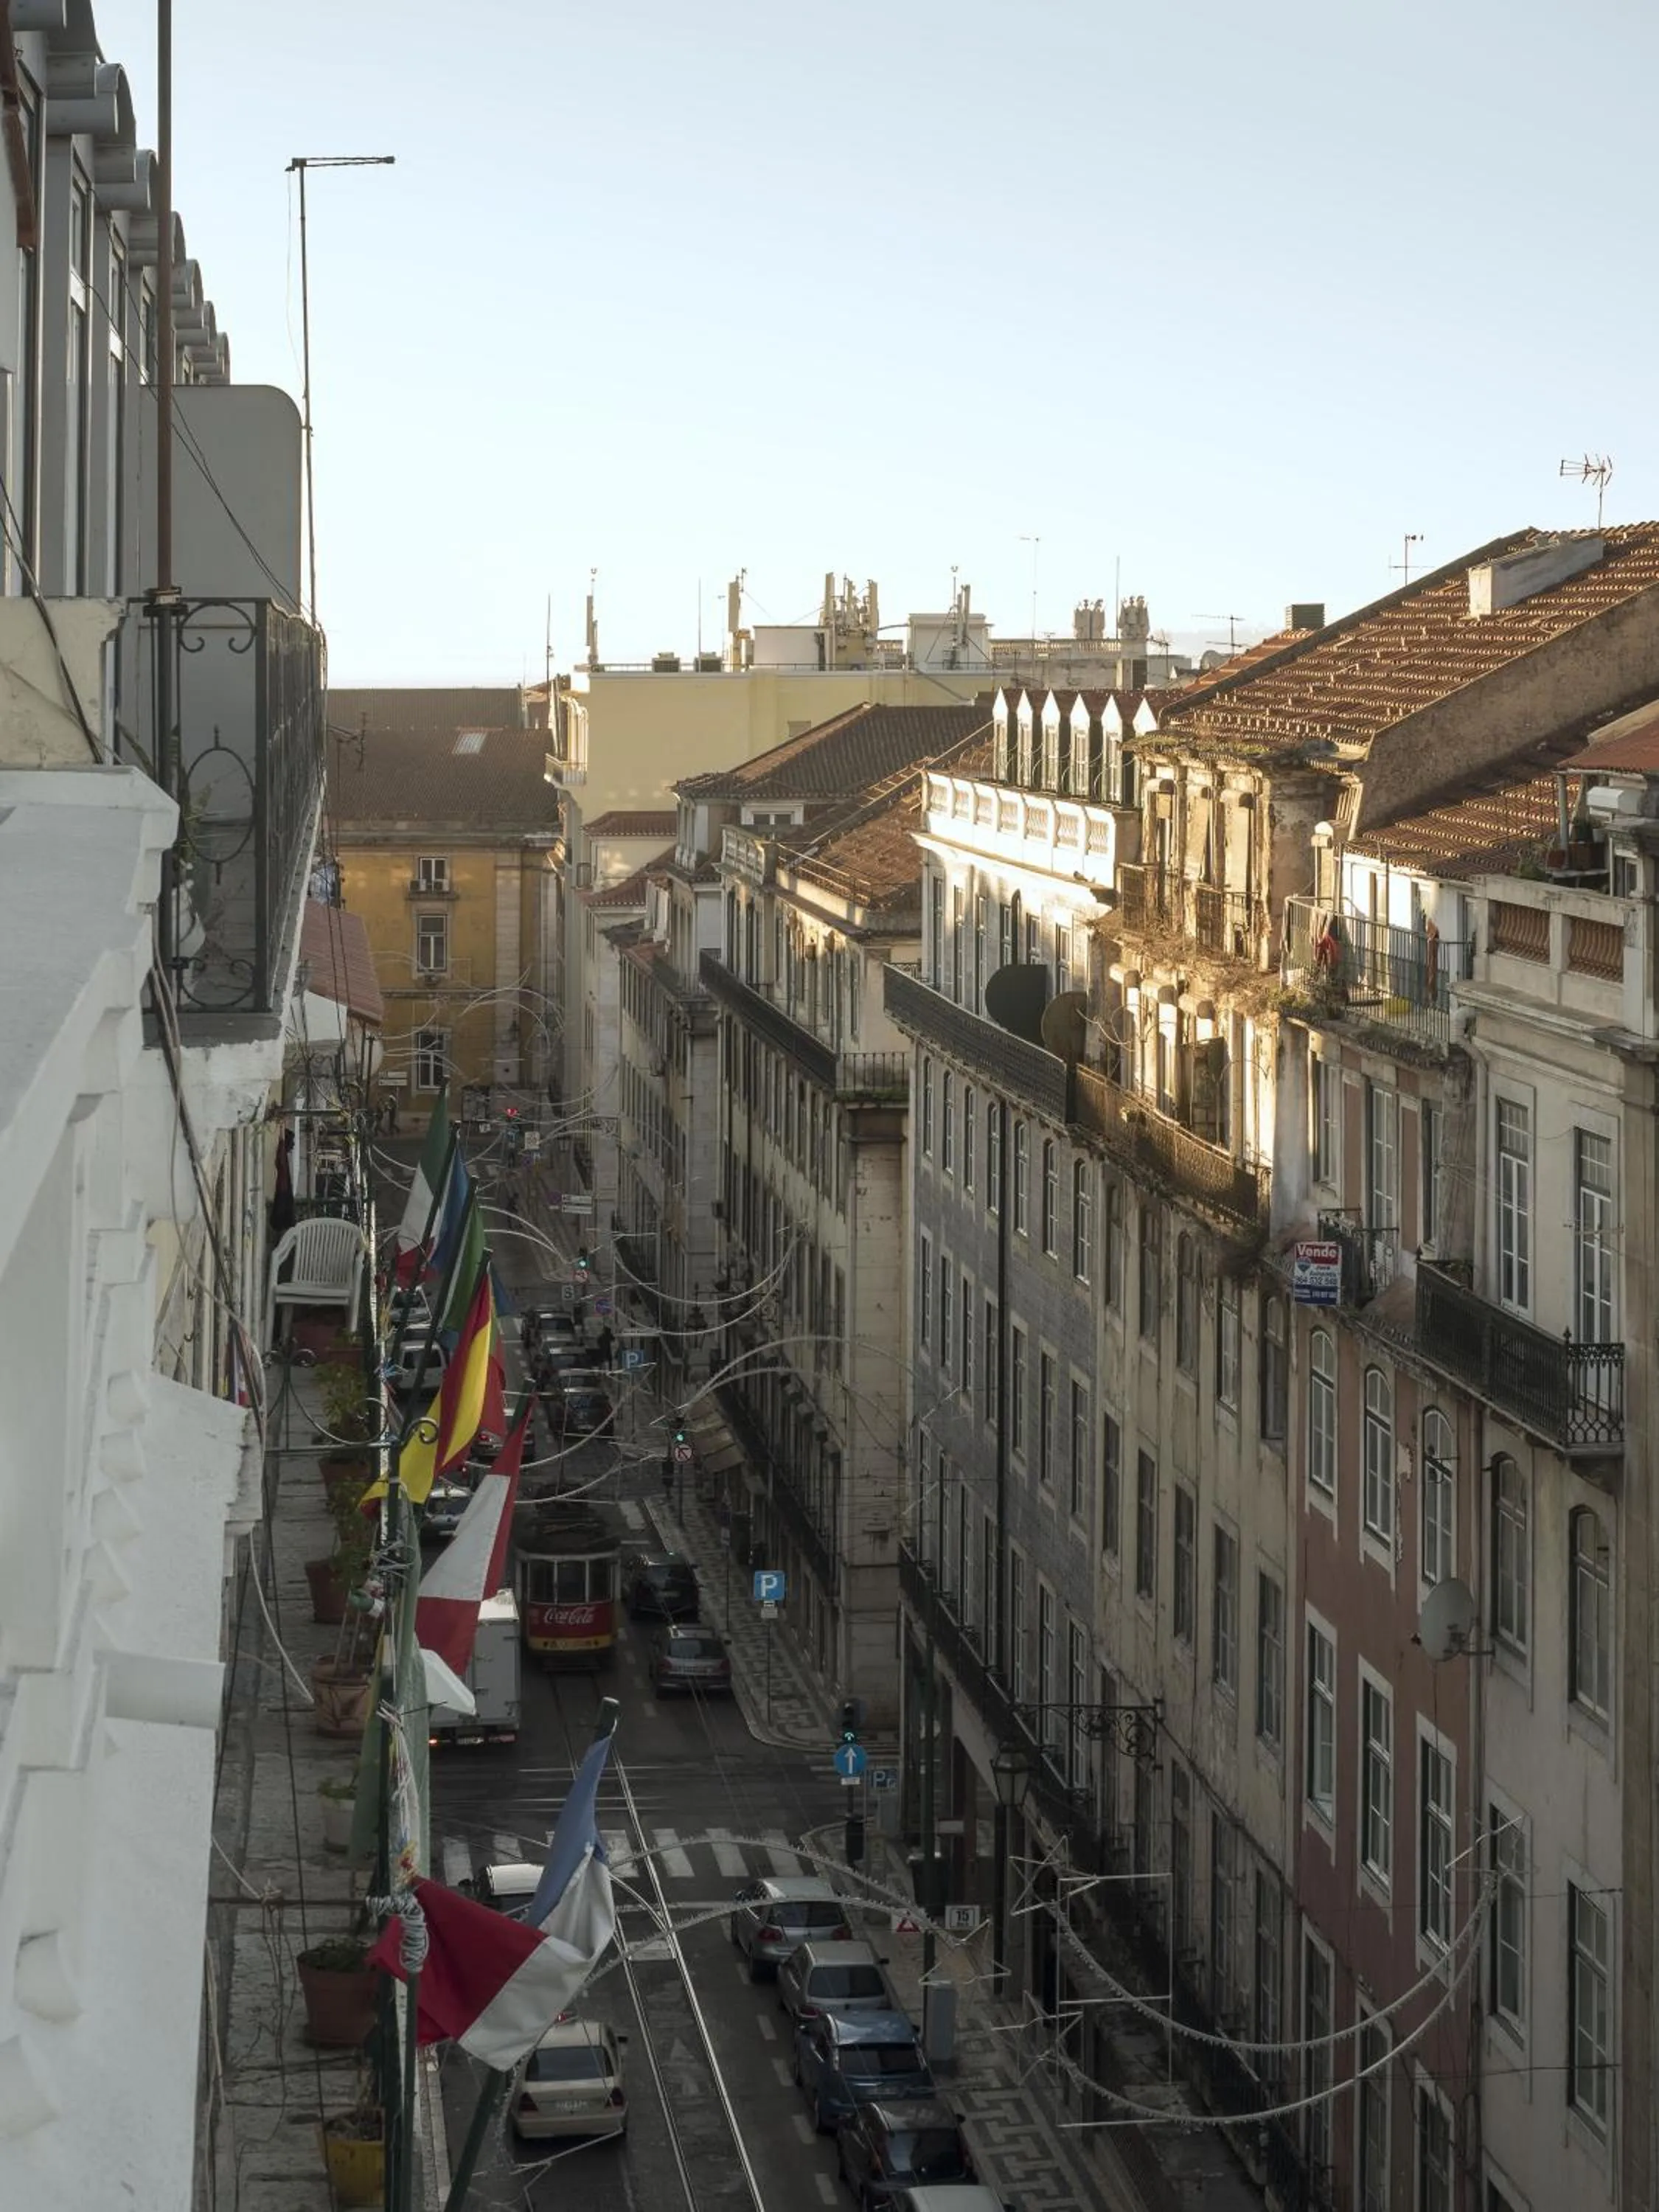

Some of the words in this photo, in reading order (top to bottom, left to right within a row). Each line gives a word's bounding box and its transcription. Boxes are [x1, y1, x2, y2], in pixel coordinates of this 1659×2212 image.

[1298, 1243, 1338, 1257] Vende
[626, 1352, 639, 1369] P
[760, 1574, 777, 1597] P
[873, 1770, 885, 1790] P
[956, 1910, 969, 1921] 15
